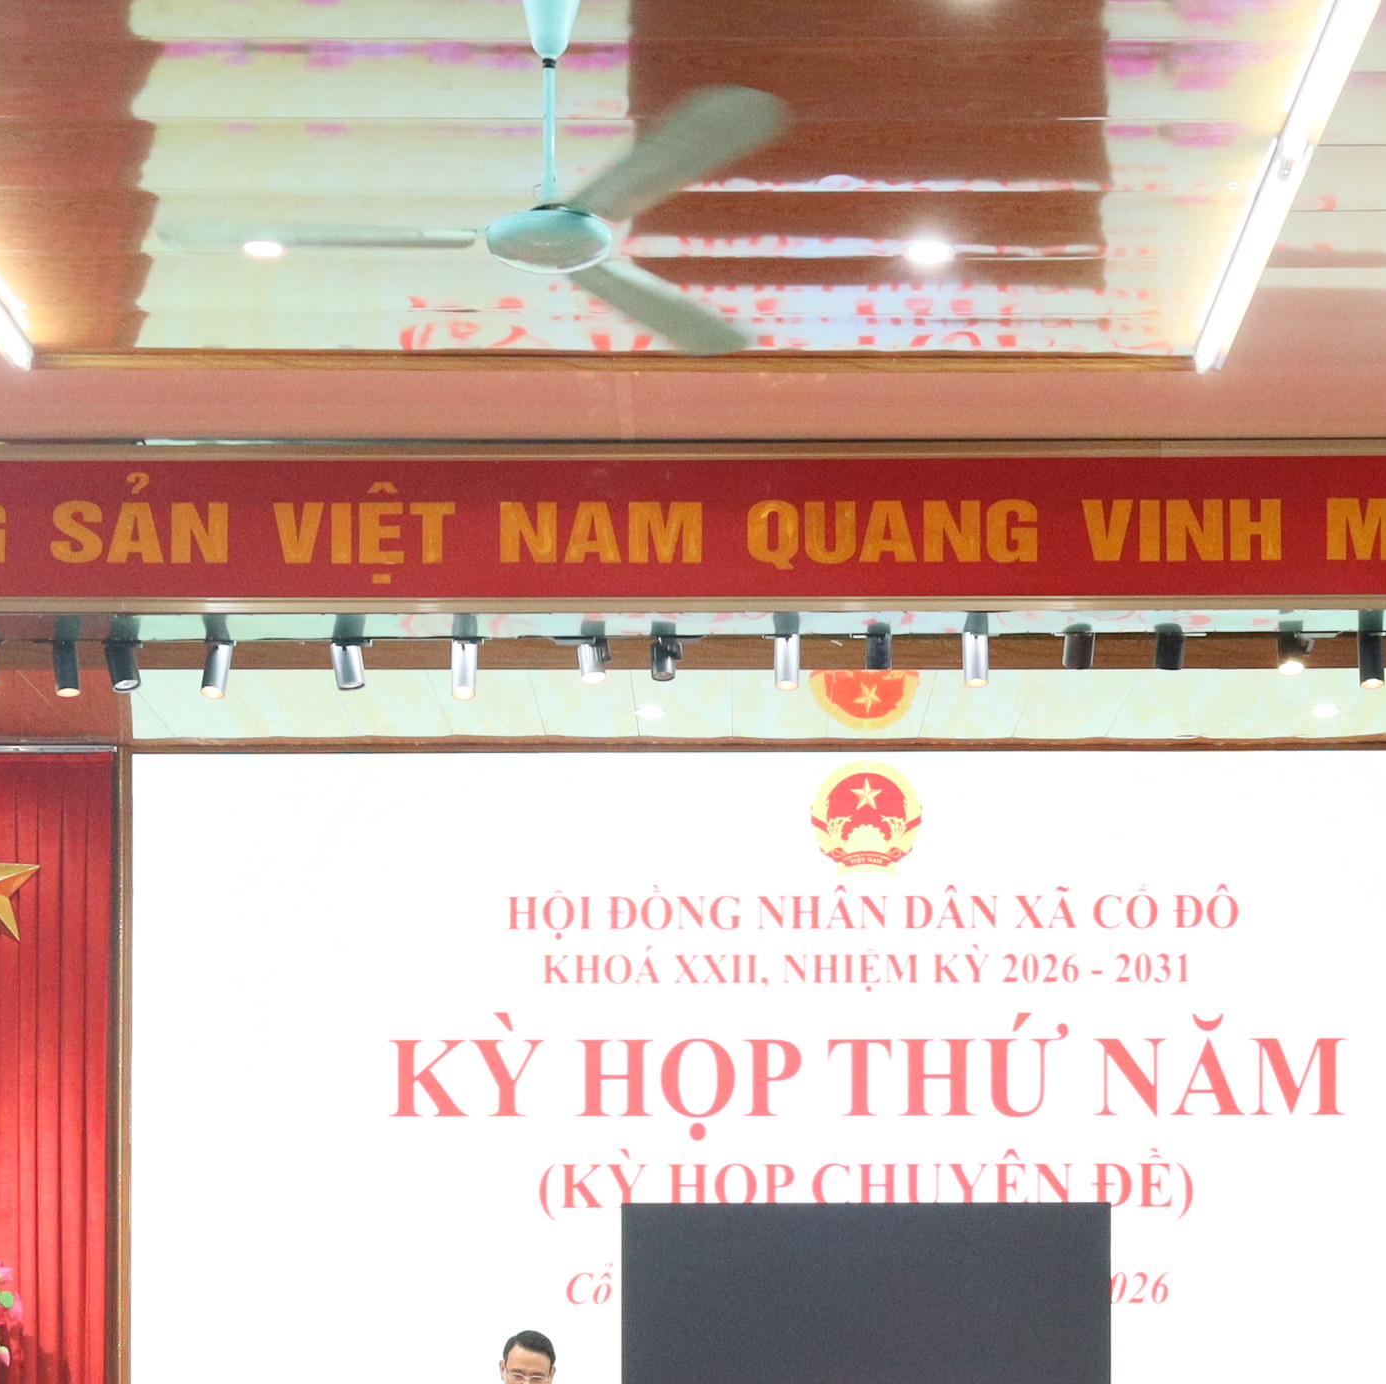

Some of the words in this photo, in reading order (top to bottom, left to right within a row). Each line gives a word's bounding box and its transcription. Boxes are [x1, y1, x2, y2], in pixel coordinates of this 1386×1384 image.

[52, 474, 228, 562] SẢN
[276, 484, 455, 583] VIỆT
[501, 502, 703, 563] NAM
[747, 500, 1037, 568] QUANG
[1083, 499, 1281, 561] VINH
[507, 890, 591, 940] HỘI
[608, 885, 741, 930] ĐỒNG
[757, 884, 888, 929] NHÂN
[904, 884, 998, 929] DÂN
[1015, 886, 1077, 928] XÃ
[1093, 885, 1159, 929] CỔ
[1173, 883, 1239, 929] ĐÔ
[544, 945, 660, 984] KHOÁ
[675, 954, 768, 987] XXII,
[783, 949, 917, 992] NHIỆM
[934, 944, 989, 983] KỲ
[1002, 953, 1079, 983] 2026
[1115, 953, 1188, 983] 2031
[390, 1012, 543, 1117] KỲ
[577, 1039, 801, 1141] HỌP
[828, 1012, 1068, 1117] THỨ
[1094, 1014, 1345, 1116] NĂM
[539, 1148, 647, 1220] (KỲ
[812, 1148, 1072, 1203] CHUYÊN
[1092, 1148, 1193, 1218] ĐỀ)
[1110, 1272, 1170, 1304] 026
